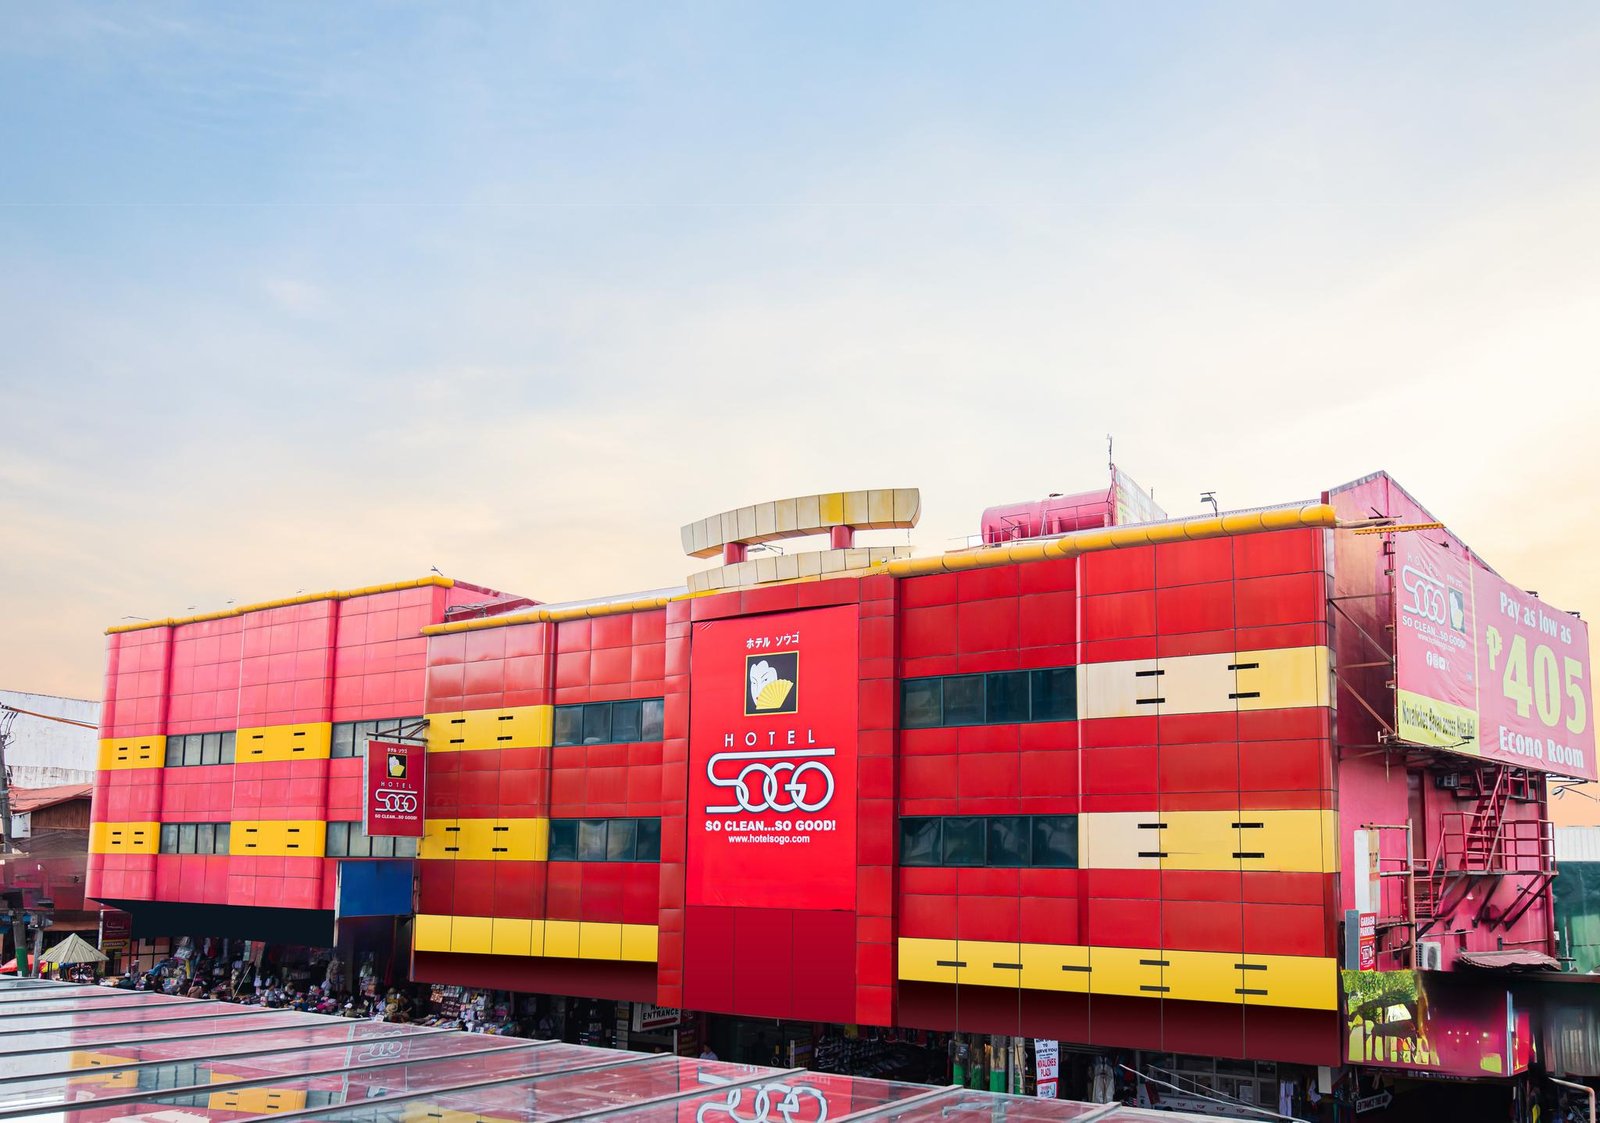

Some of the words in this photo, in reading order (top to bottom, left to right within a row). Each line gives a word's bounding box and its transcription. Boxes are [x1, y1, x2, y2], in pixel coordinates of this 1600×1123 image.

[1402, 564, 1447, 626] SOGO
[1402, 615, 1413, 628] SO
[1499, 591, 1520, 625] Pay
[1524, 607, 1536, 628] as
[1539, 609, 1558, 638] low
[1560, 625, 1572, 645] as
[746, 637, 771, 649] ホテル
[775, 631, 800, 647] ソウゴ
[725, 729, 816, 747] HOTEL
[1498, 725, 1543, 759] Econo
[1547, 738, 1584, 768] Room
[381, 781, 412, 789] HOTEL
[705, 747, 836, 814] SOGO
[374, 788, 418, 813] SOGO
[705, 820, 722, 831] SO
[795, 820, 836, 831] GOOD!
[728, 834, 810, 845] www.hotelsogo.com
[642, 1008, 680, 1020] ENTRANCE
